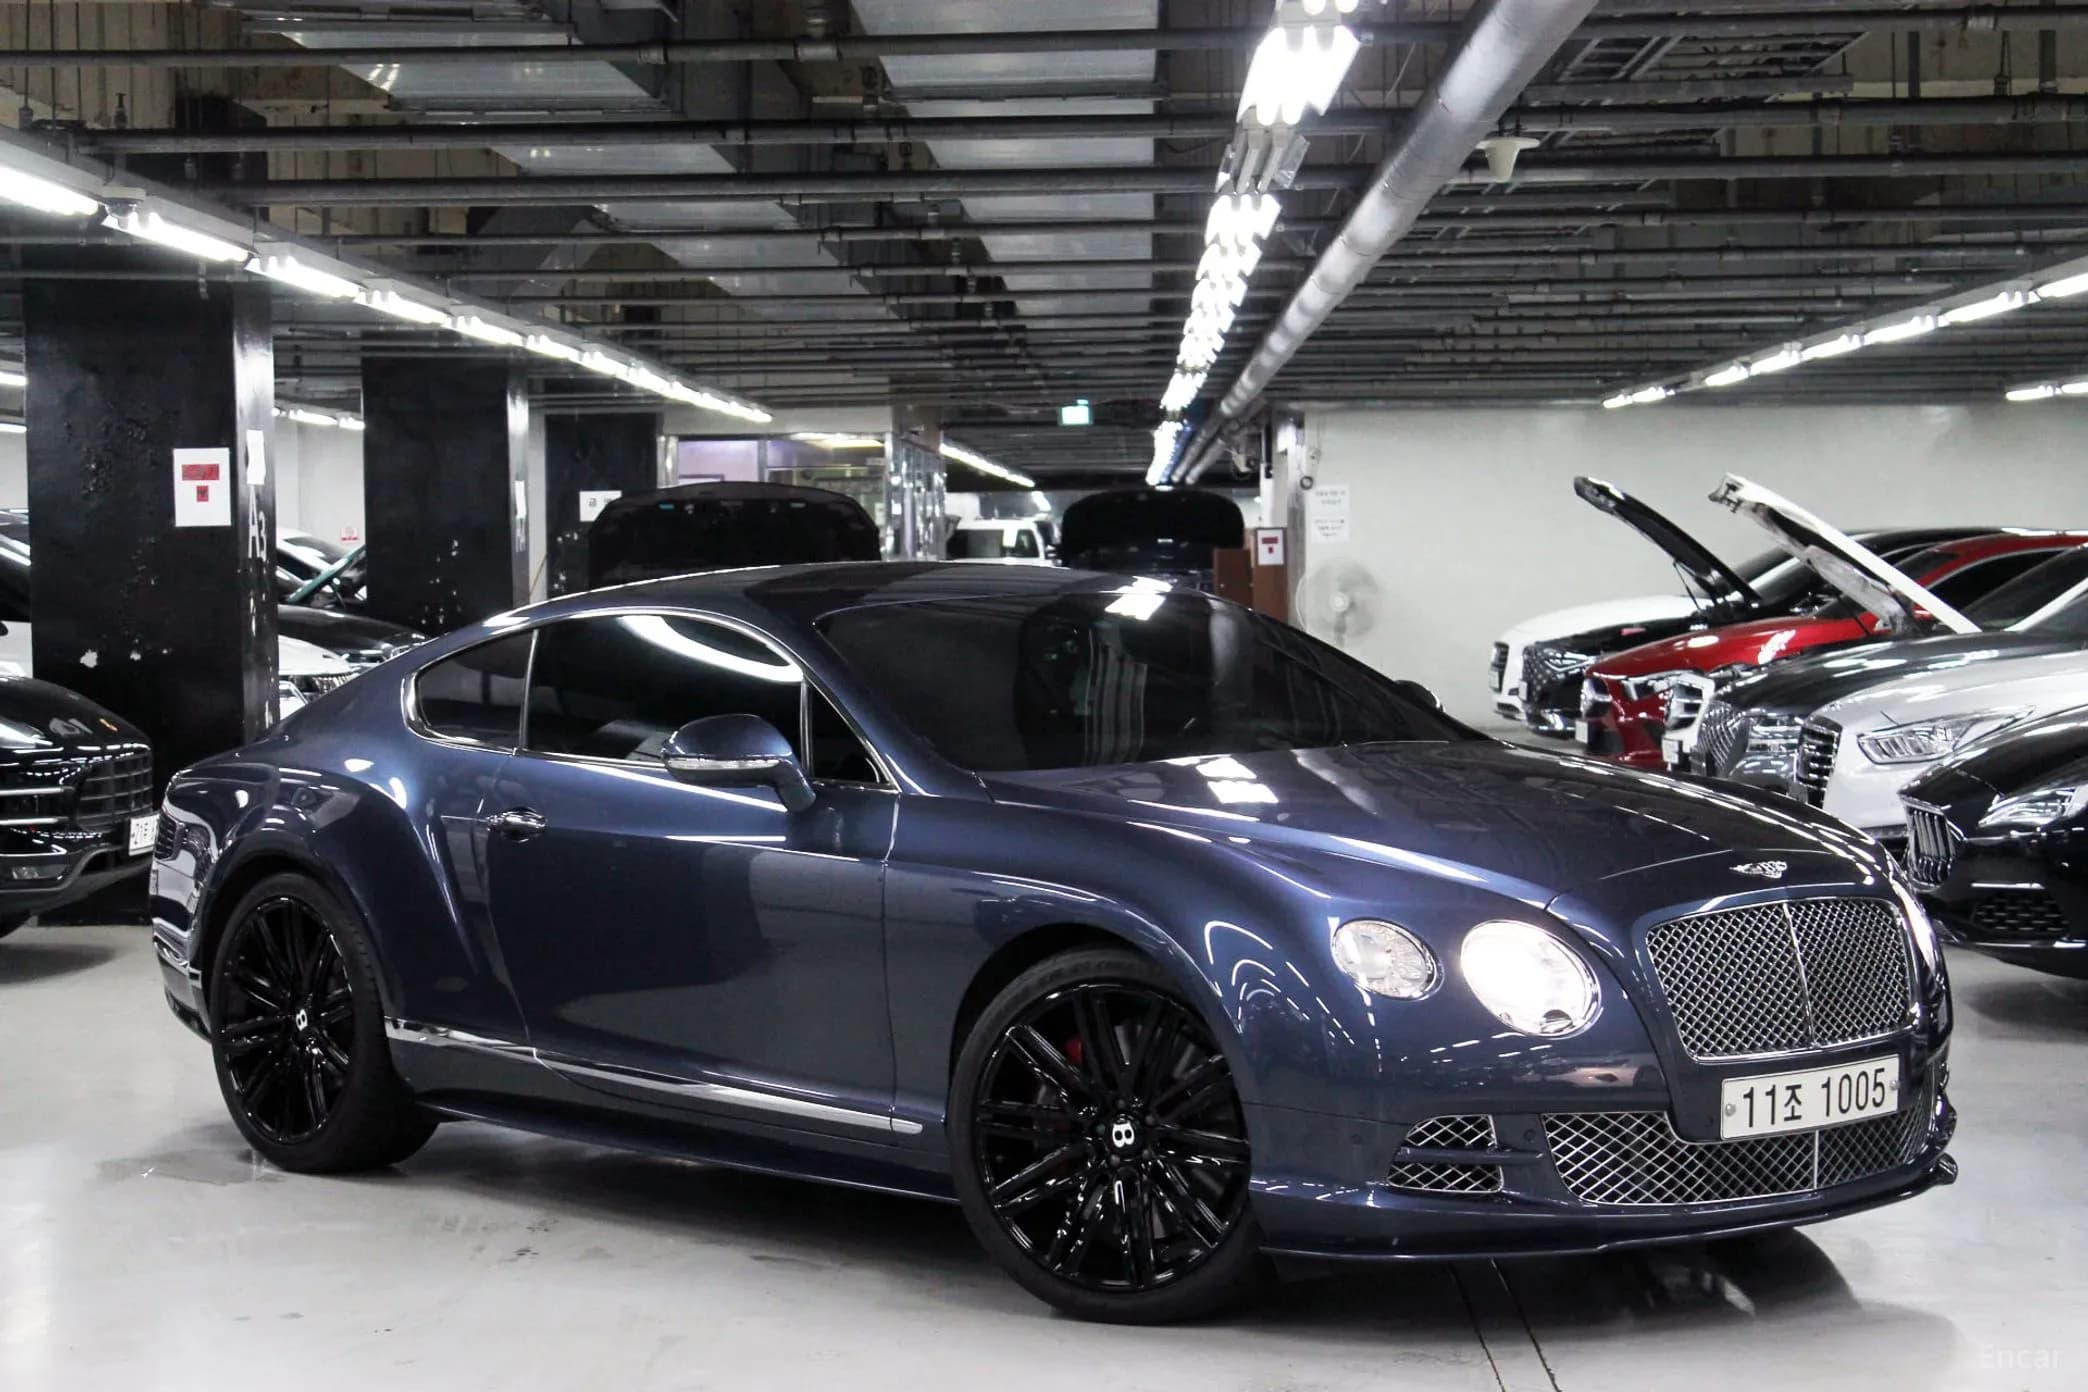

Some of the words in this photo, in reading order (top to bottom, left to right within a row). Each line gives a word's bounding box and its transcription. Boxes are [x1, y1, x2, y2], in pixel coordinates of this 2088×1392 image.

[1743, 1084, 1802, 1128] 11조
[1821, 1067, 1886, 1117] 1005
[1112, 1120, 1135, 1148] B
